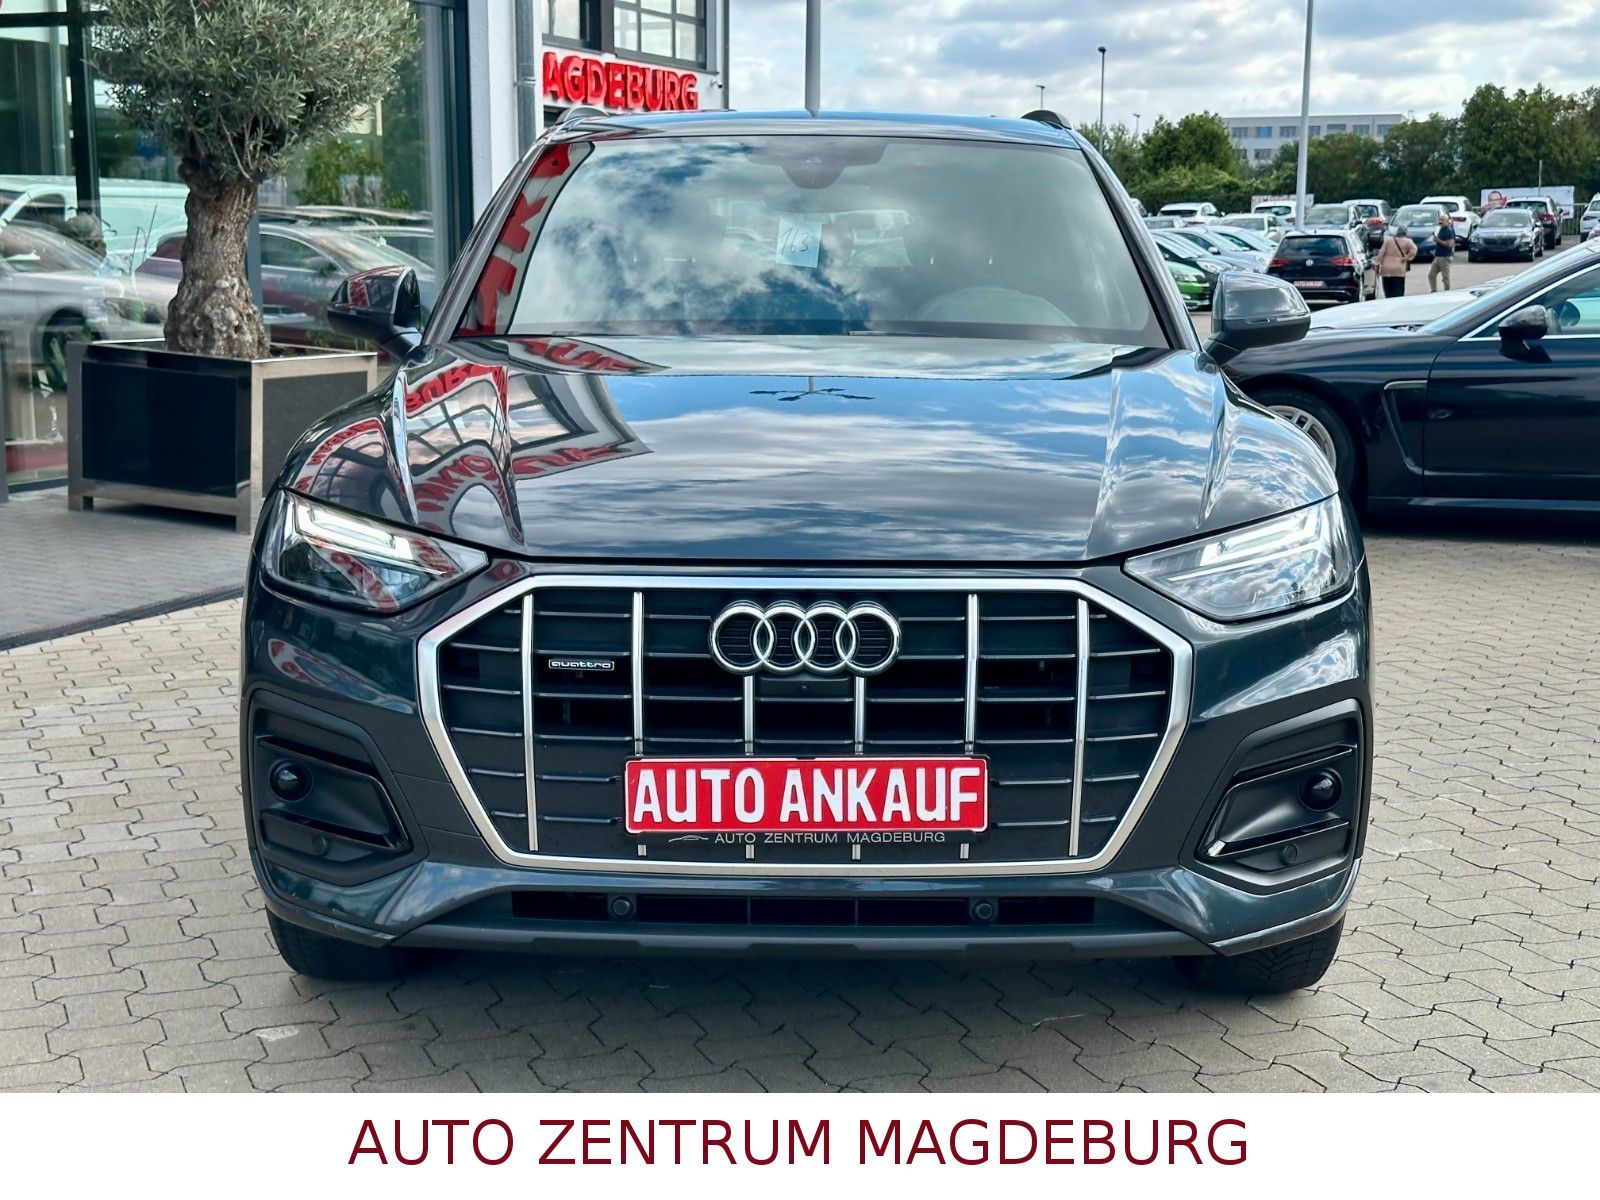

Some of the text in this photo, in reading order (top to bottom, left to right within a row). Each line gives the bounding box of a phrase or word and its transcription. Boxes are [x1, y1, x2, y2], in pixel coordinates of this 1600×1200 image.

[550, 660, 612, 669] quattro
[634, 766, 980, 823] AUTO ANKAUF
[714, 831, 946, 845] AUTO ZENTRUM MAGDEBURG
